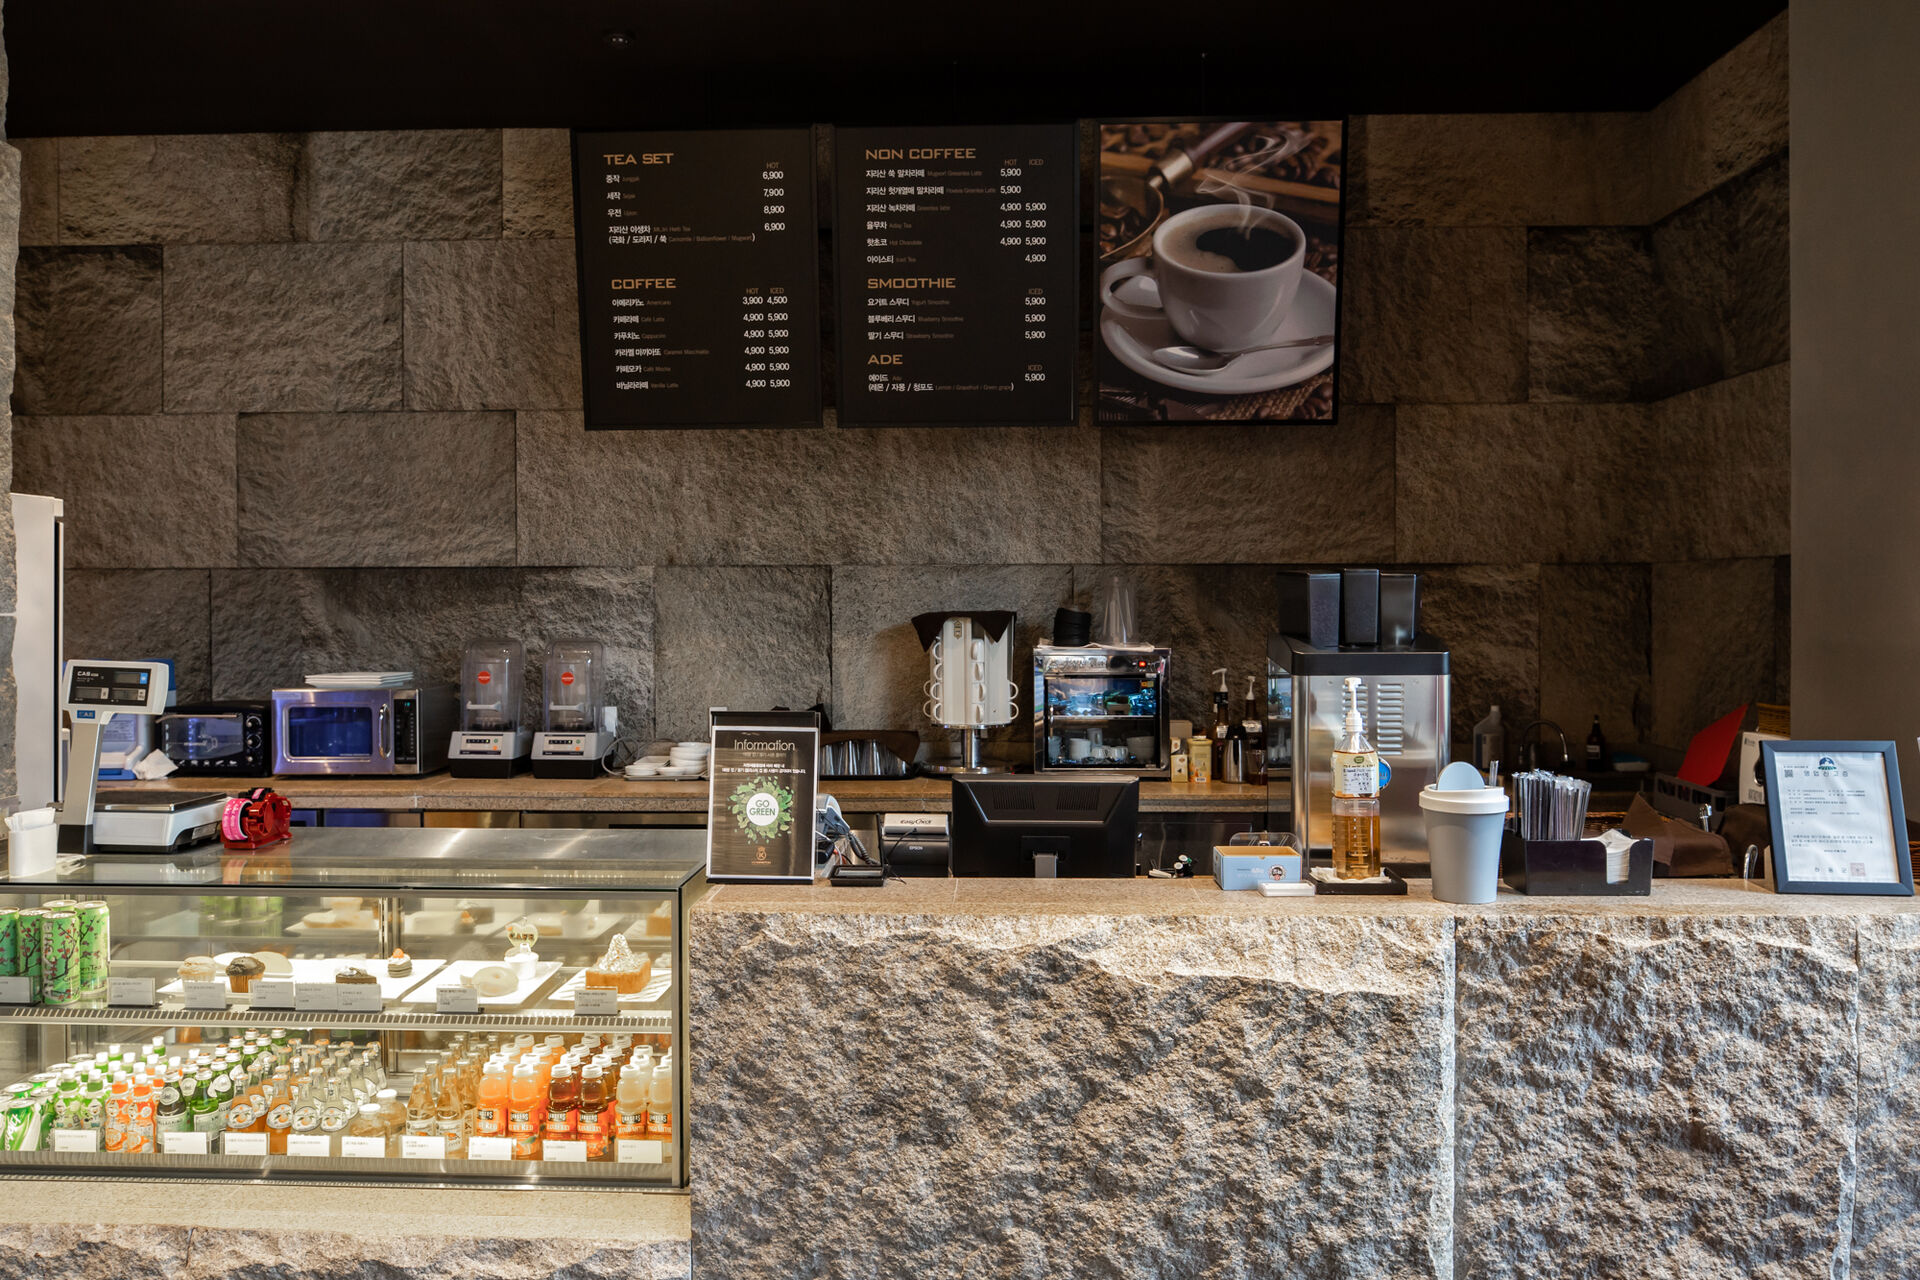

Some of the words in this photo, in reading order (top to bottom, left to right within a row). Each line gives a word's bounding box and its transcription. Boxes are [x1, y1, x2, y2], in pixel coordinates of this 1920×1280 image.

[866, 149, 903, 159] NON
[909, 149, 976, 159] COFFEE
[604, 155, 637, 165] TEA
[643, 153, 673, 164] SET
[763, 171, 783, 180] 6,900
[866, 170, 886, 178] 지리산
[1001, 169, 1021, 177] 5,900
[606, 175, 620, 183] 중작
[764, 189, 784, 197] 7,900
[866, 187, 886, 195] 지리산
[1001, 186, 1021, 194] 5,900
[607, 192, 620, 200] 세작
[764, 206, 784, 214] 8,900
[866, 204, 886, 212] 지리산
[1001, 203, 1021, 211] 4,900
[1026, 203, 1046, 211] 5,900
[608, 209, 621, 217] 우전
[764, 223, 785, 231] 6,900
[867, 221, 887, 229] 율무차
[1001, 220, 1021, 228] 4,900
[1026, 220, 1046, 228] 5,900
[609, 226, 628, 234] 지리산
[1001, 237, 1021, 245] 4,900
[1026, 237, 1046, 245] 5,900
[1025, 254, 1046, 262] 4,900
[612, 278, 676, 289] COFFEE
[868, 278, 955, 288] SMOOTHIE
[743, 297, 763, 305] 3,900
[767, 296, 787, 304] 4,500
[868, 298, 887, 306] 요거트
[890, 298, 909, 306] 스무디
[1025, 297, 1046, 305] 5,900
[743, 313, 763, 322] 4,900
[768, 313, 788, 321] 5,900
[868, 315, 894, 323] 블루베리
[895, 315, 915, 323] 스무디
[1025, 314, 1046, 322] 5,900
[614, 332, 640, 340] 카푸치노
[744, 330, 764, 338] 4,900
[768, 330, 788, 338] 5,900
[868, 332, 881, 340] 딸기
[884, 332, 904, 340] 스무디
[1025, 331, 1045, 339] 5,900
[745, 347, 765, 355] 4,900
[769, 346, 789, 354] 5,900
[868, 355, 903, 365] ADE
[745, 363, 765, 371] 4,900
[769, 363, 789, 371] 5,900
[869, 374, 888, 382] 에이드
[746, 380, 766, 388] 4,900
[770, 379, 790, 388] 5,900
[734, 739, 796, 751] Information
[755, 800, 770, 808] GO
[749, 808, 776, 816] GREEN
